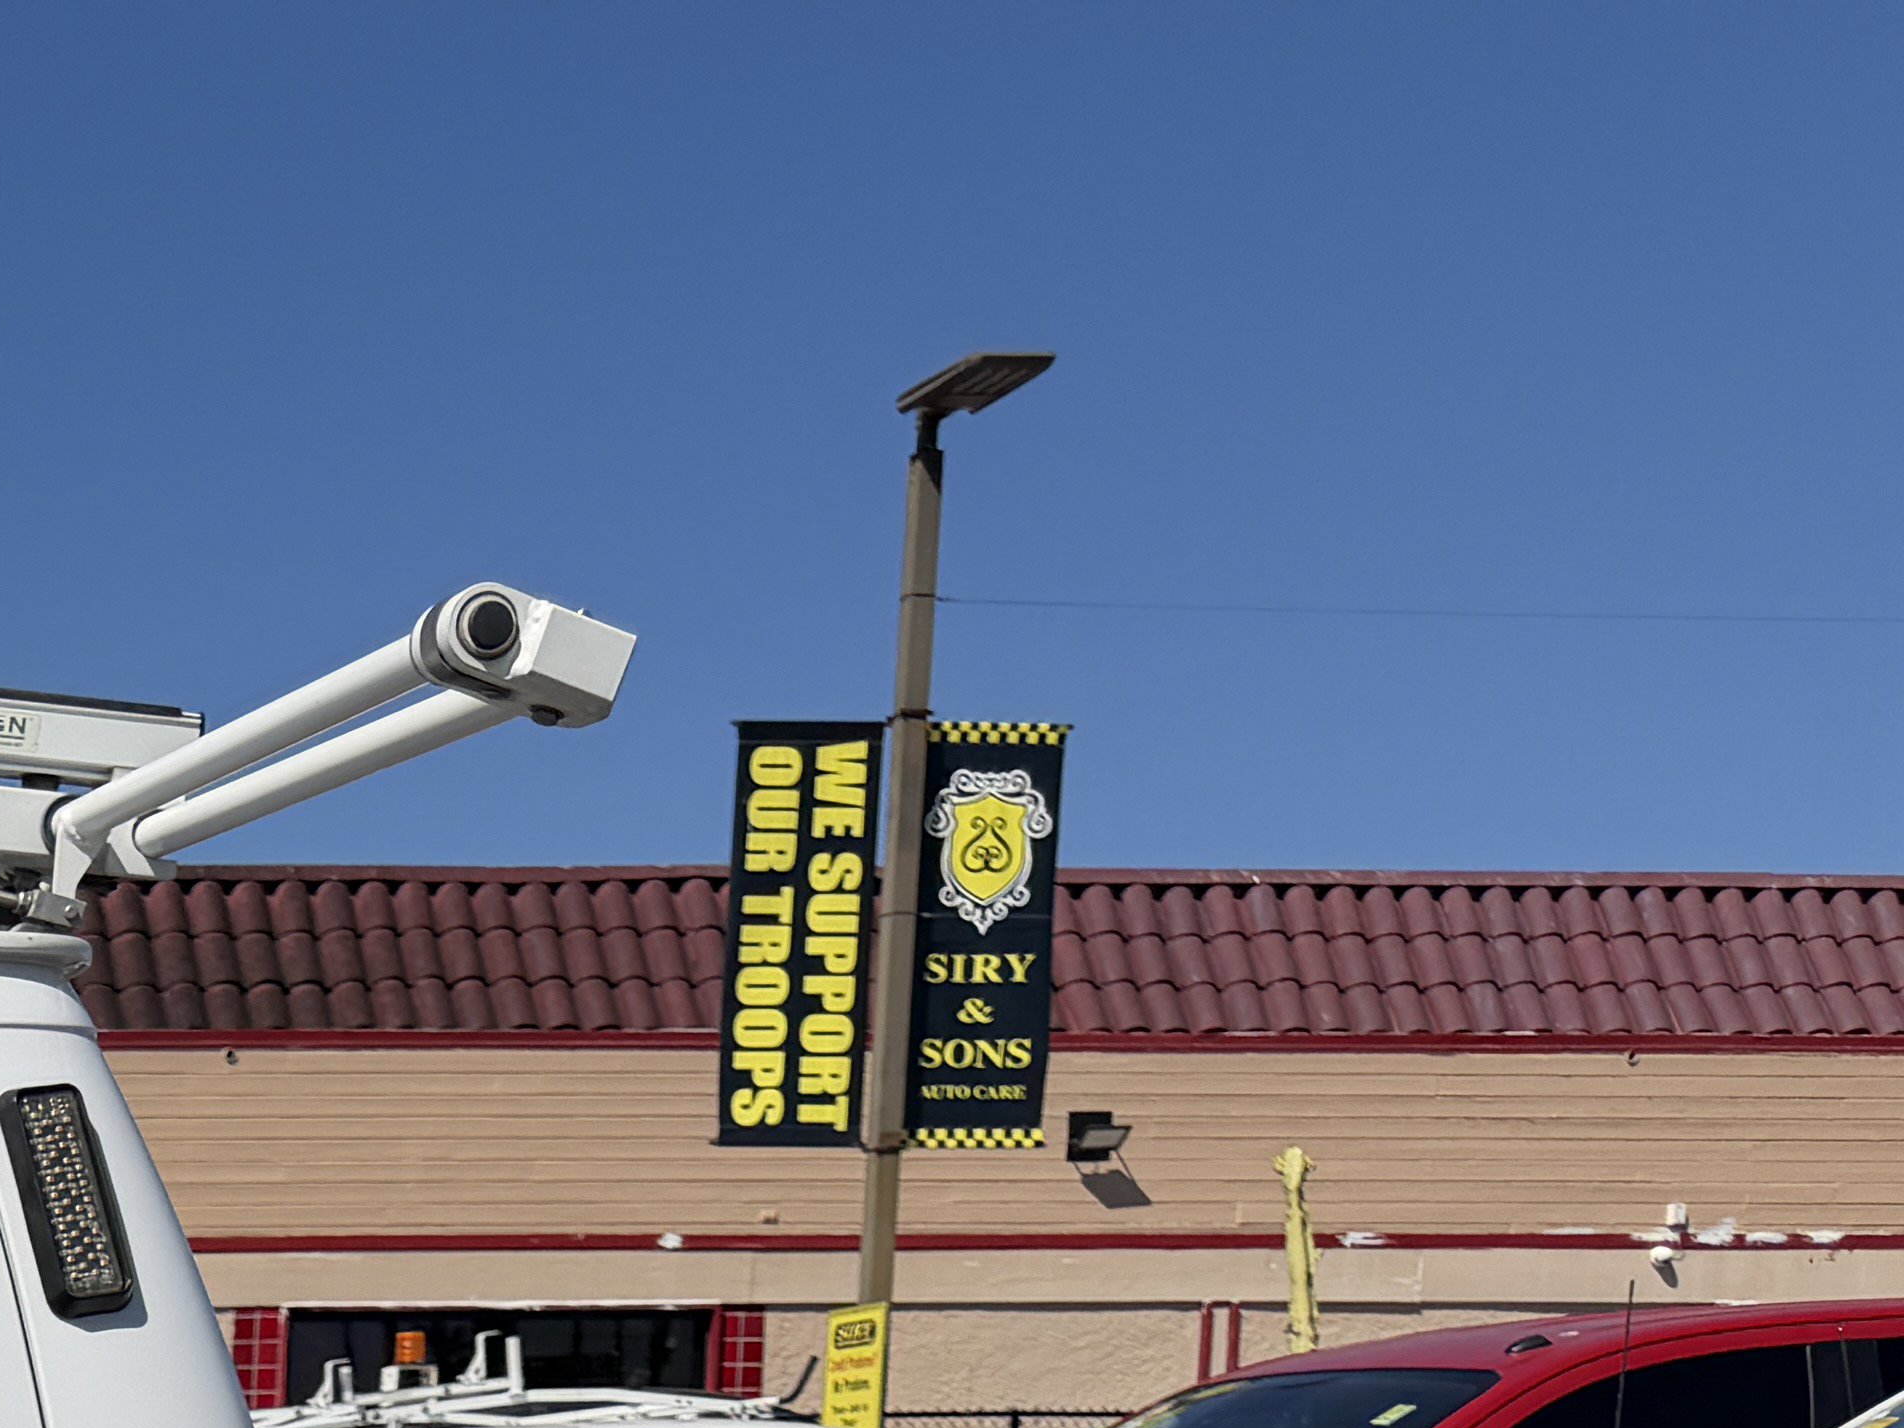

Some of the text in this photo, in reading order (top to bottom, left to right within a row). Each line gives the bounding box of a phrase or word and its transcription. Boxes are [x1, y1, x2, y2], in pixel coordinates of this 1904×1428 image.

[730, 745, 803, 1127] OUR TROOPS
[796, 740, 869, 1132] WE SUPPORT
[923, 952, 1038, 985] SIRY
[956, 997, 996, 1025] &
[918, 1037, 1032, 1071] SONS
[920, 1083, 1028, 1101] AUTO CARE
